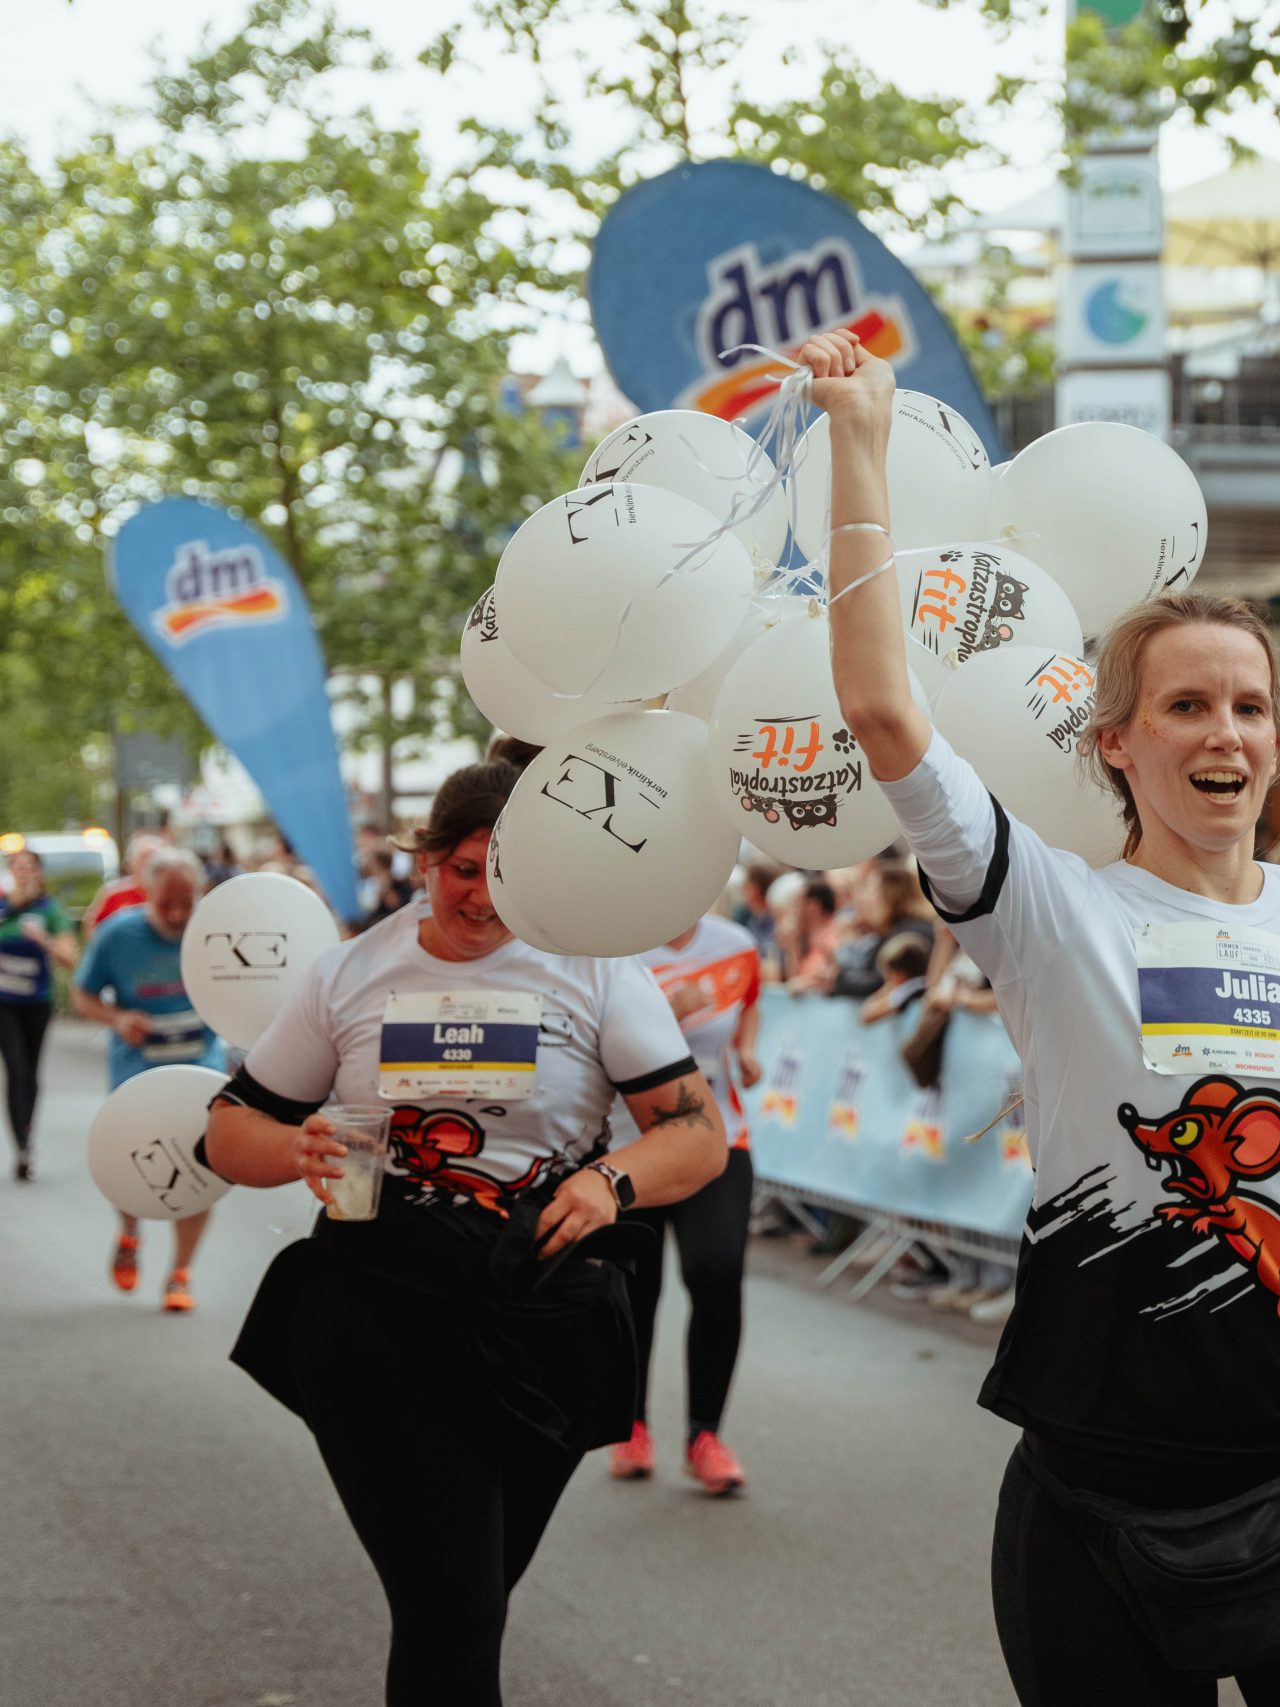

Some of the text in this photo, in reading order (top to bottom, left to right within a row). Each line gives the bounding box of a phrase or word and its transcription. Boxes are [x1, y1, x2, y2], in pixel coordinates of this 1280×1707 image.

[711, 254, 853, 369] dm
[175, 549, 258, 602] dm
[918, 567, 967, 633] fit
[1037, 656, 1094, 704] fit
[752, 720, 825, 772] fit
[729, 760, 862, 798] Katzastrophal
[1218, 942, 1239, 950] FIRMEN
[1219, 949, 1239, 959] LAUF
[1233, 1007, 1272, 1026] 4335
[433, 1022, 485, 1045] Leah
[1175, 1044, 1190, 1053] dm
[442, 1049, 473, 1061] 4330
